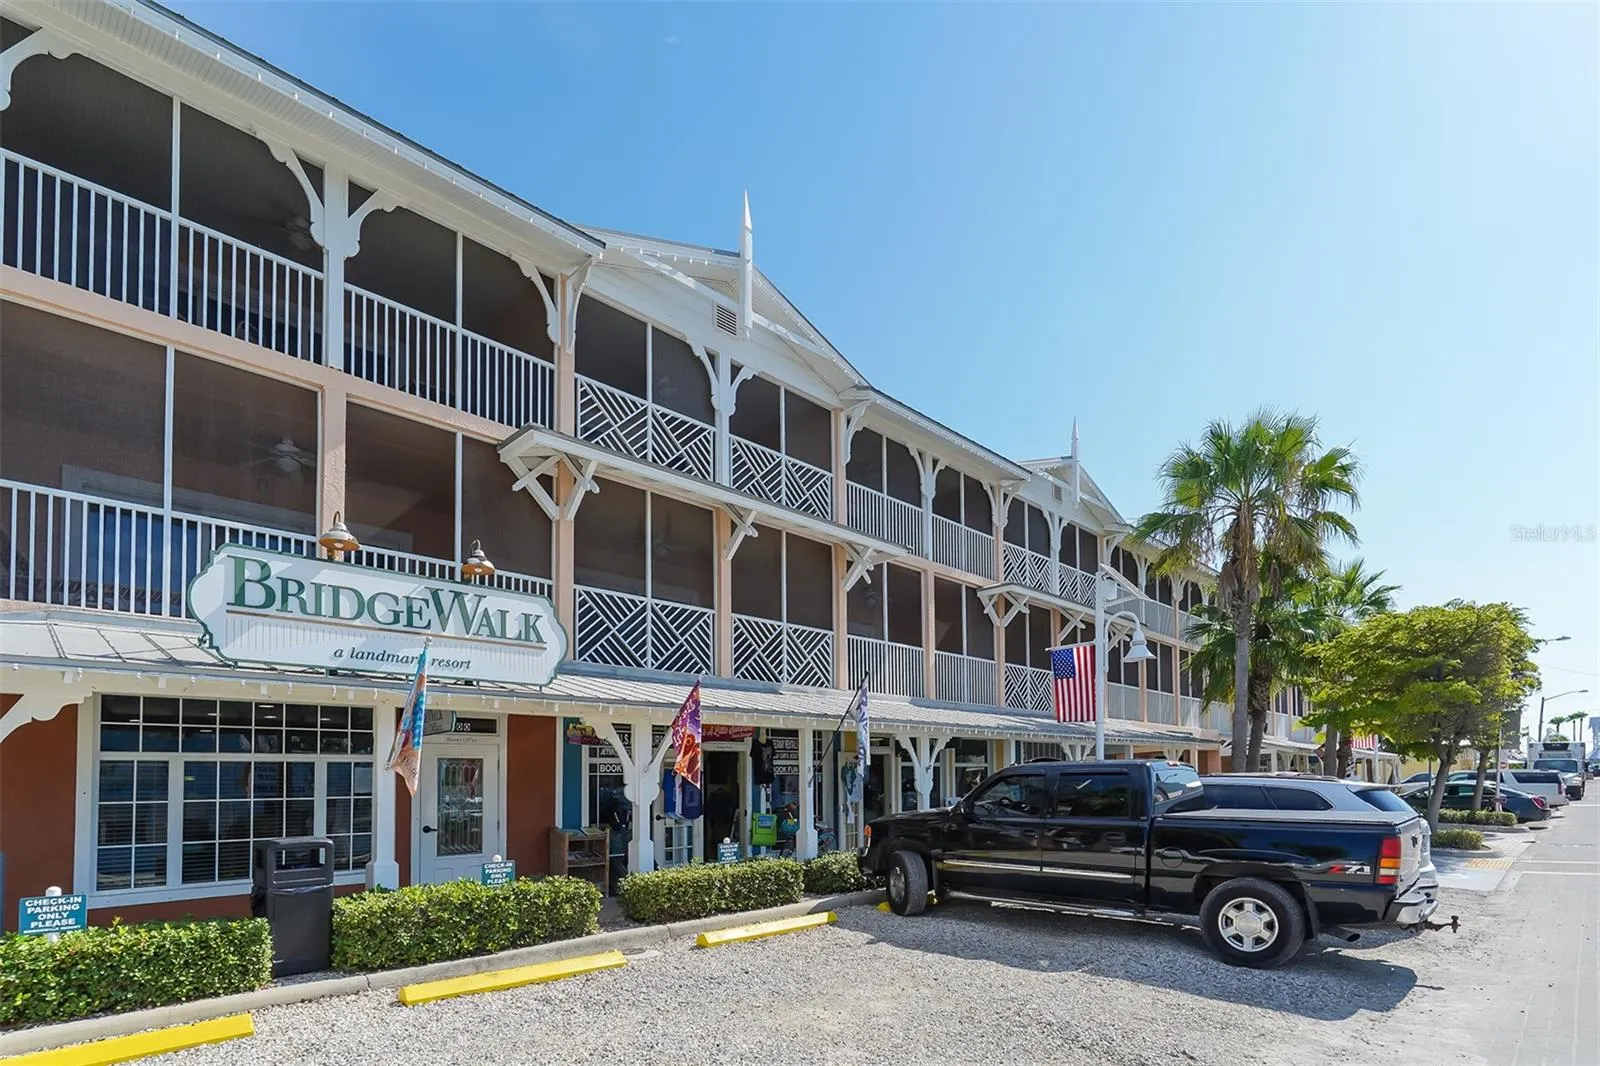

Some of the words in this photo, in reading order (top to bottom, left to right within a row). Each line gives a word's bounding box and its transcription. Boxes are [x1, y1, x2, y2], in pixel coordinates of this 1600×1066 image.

[333, 648, 344, 658] a
[350, 648, 421, 665] landmar
[431, 657, 472, 670] resort
[600, 763, 622, 772] BOOK
[25, 896, 82, 907] CHECK-IN
[27, 903, 80, 914] PARKING
[37, 911, 70, 920] ONLY
[30, 918, 76, 928] PLEASE
